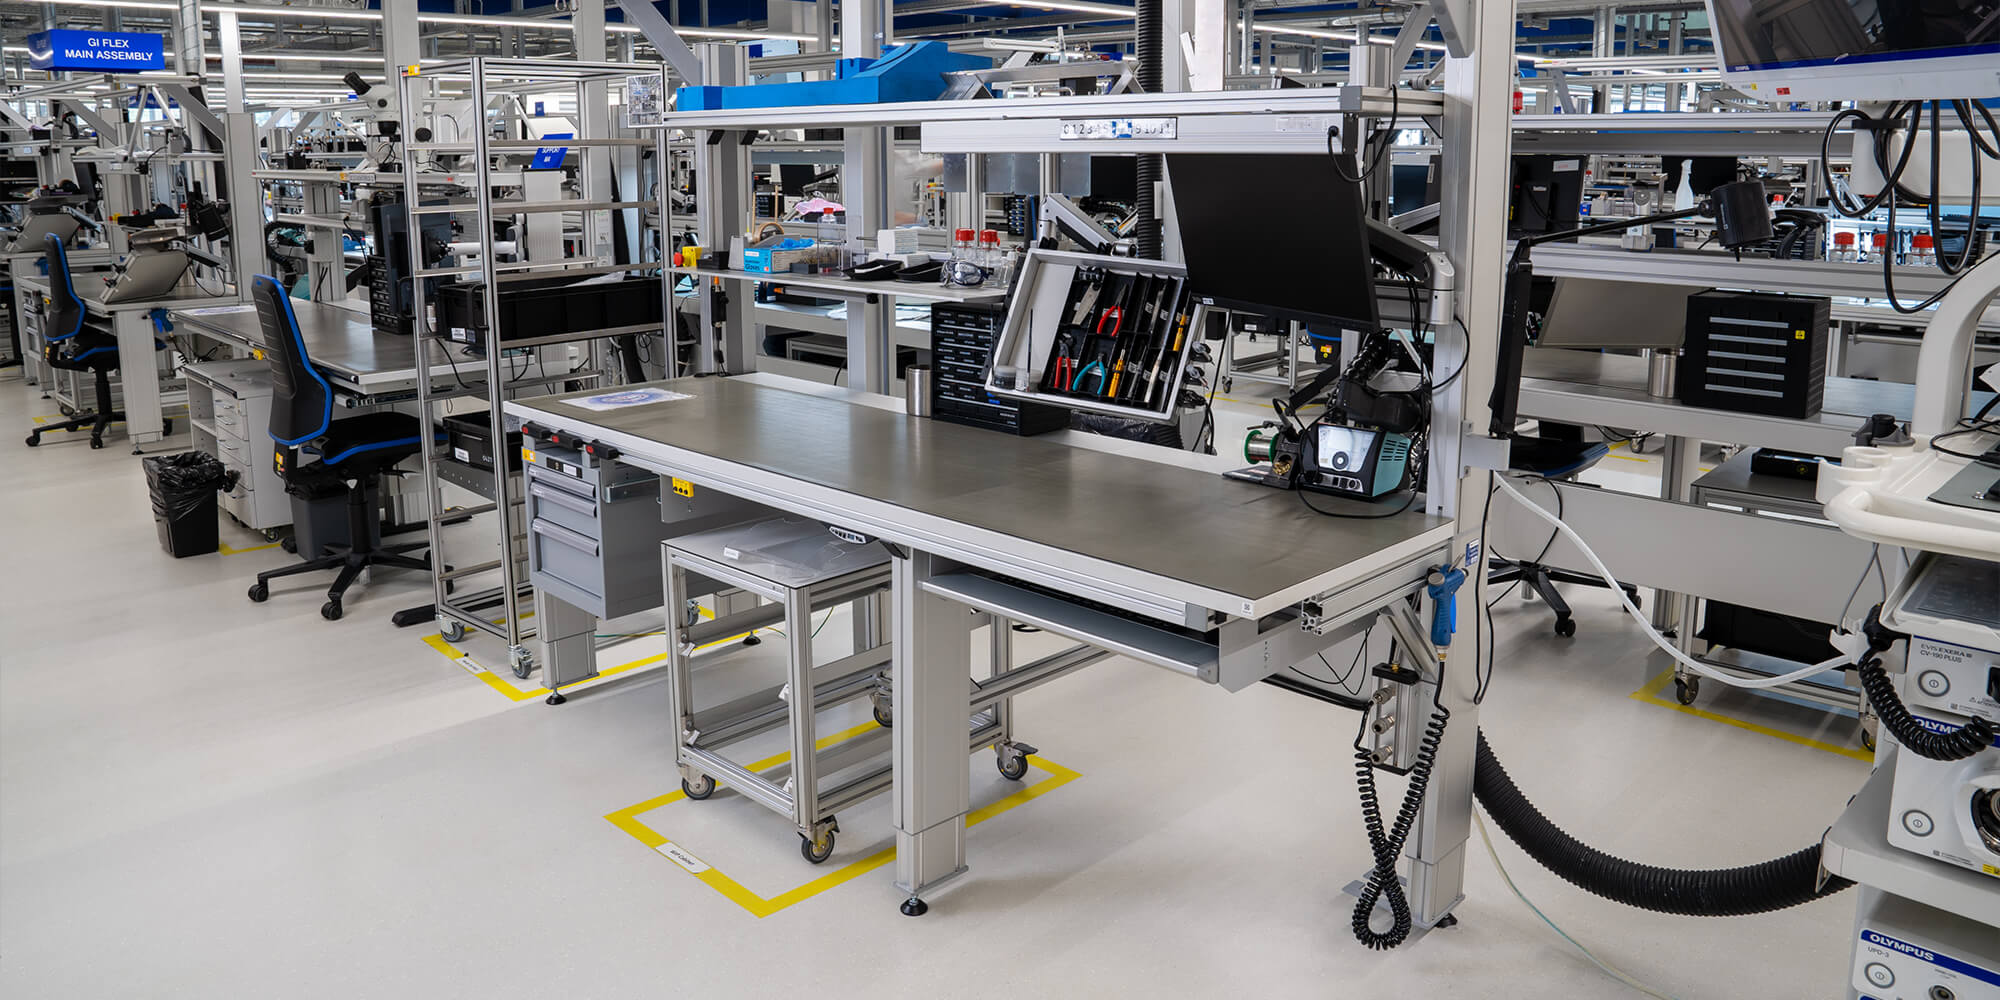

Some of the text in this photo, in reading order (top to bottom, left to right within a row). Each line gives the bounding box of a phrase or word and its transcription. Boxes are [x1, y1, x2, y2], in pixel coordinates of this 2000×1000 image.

[87, 37, 129, 48] GI FLEX
[65, 49, 153, 61] MAIN ASSEMBLY
[1920, 649, 1963, 664] CV-190 PLUS
[1939, 646, 1965, 657] EXERA
[1868, 946, 1890, 958] UPD-3
[1869, 933, 1935, 961] OLYMPUS
